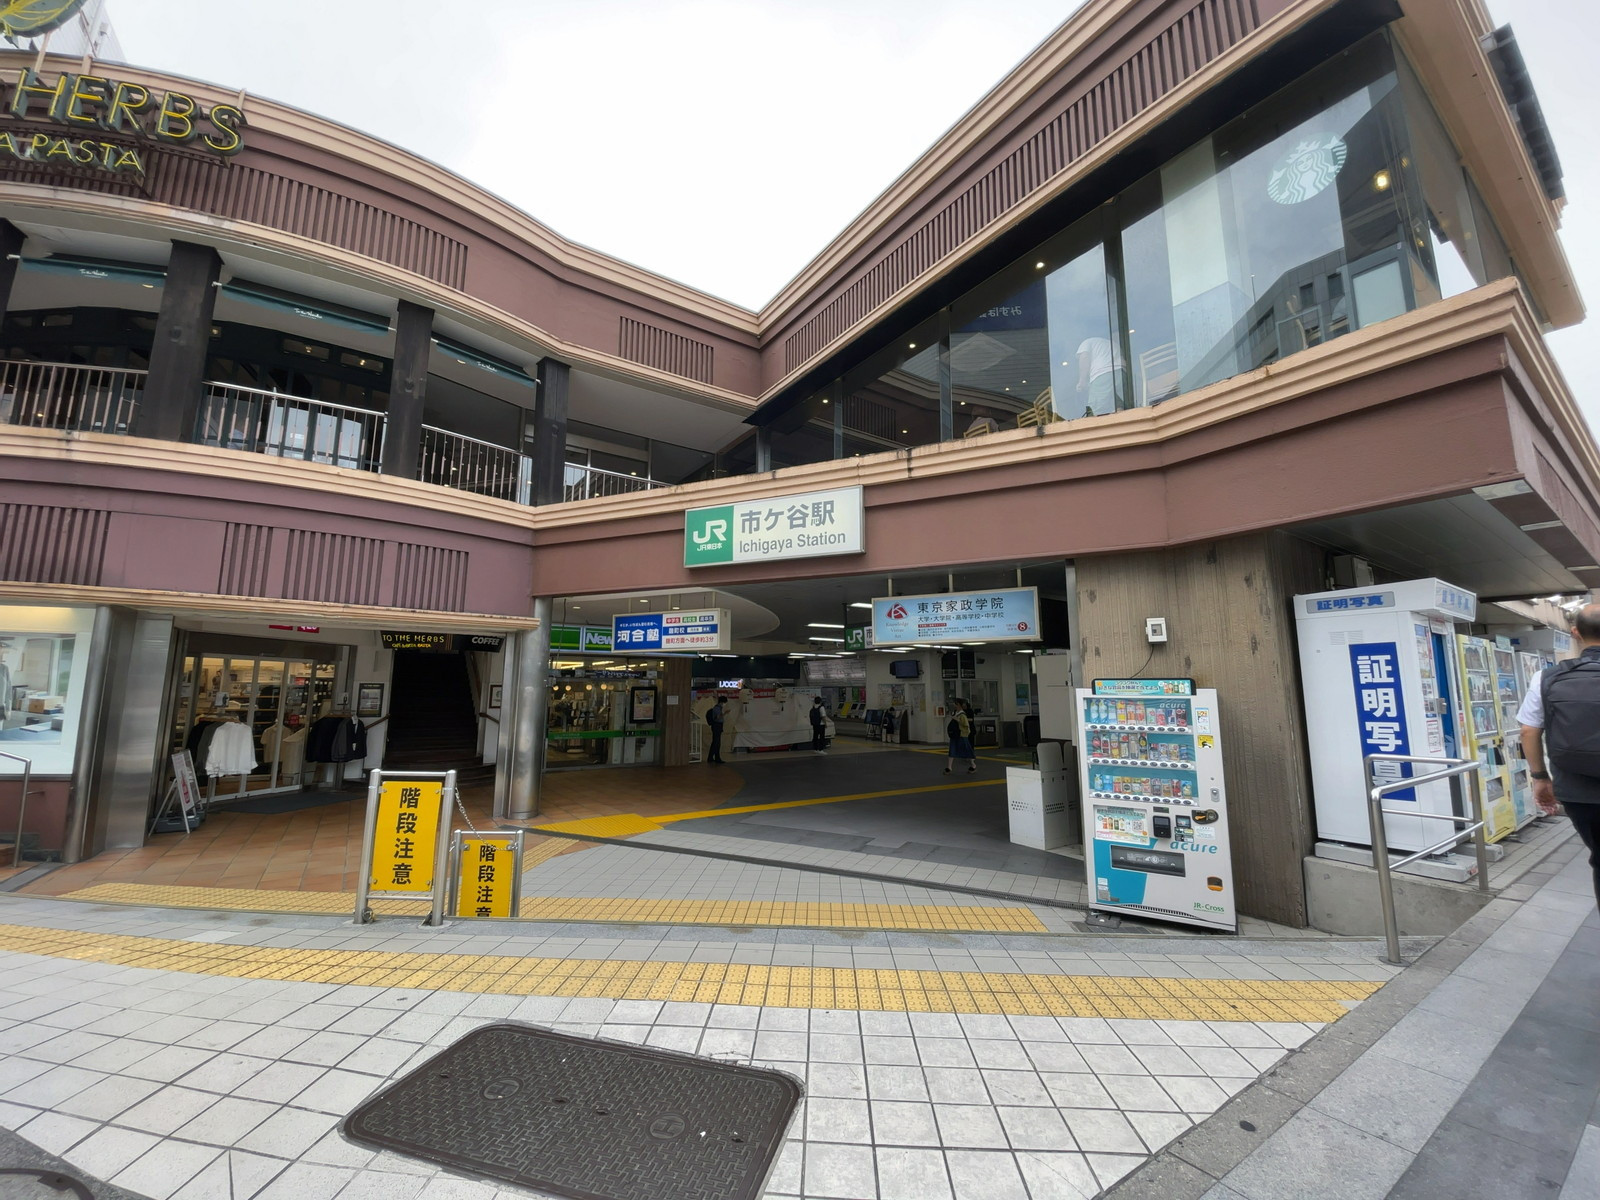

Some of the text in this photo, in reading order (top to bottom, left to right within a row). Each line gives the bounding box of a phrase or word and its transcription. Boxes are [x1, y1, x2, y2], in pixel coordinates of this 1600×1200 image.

[10, 67, 248, 157] HERBS
[28, 132, 147, 180] PASTA
[740, 500, 835, 535] 市ケ谷駅
[692, 519, 728, 544] JR
[696, 542, 723, 552] JR東日本
[739, 530, 846, 555] Ichigaya Station
[917, 597, 1004, 614] 東京家政学院
[1316, 594, 1384, 611] 証明写真
[382, 634, 445, 643] TO THE HERBS
[471, 636, 501, 646] COFFEE
[617, 628, 660, 644] 河合塾
[848, 630, 863, 644] JR
[392, 787, 421, 885] 階段注意
[1170, 840, 1218, 854] acure
[1193, 902, 1225, 913] JR-Cross
